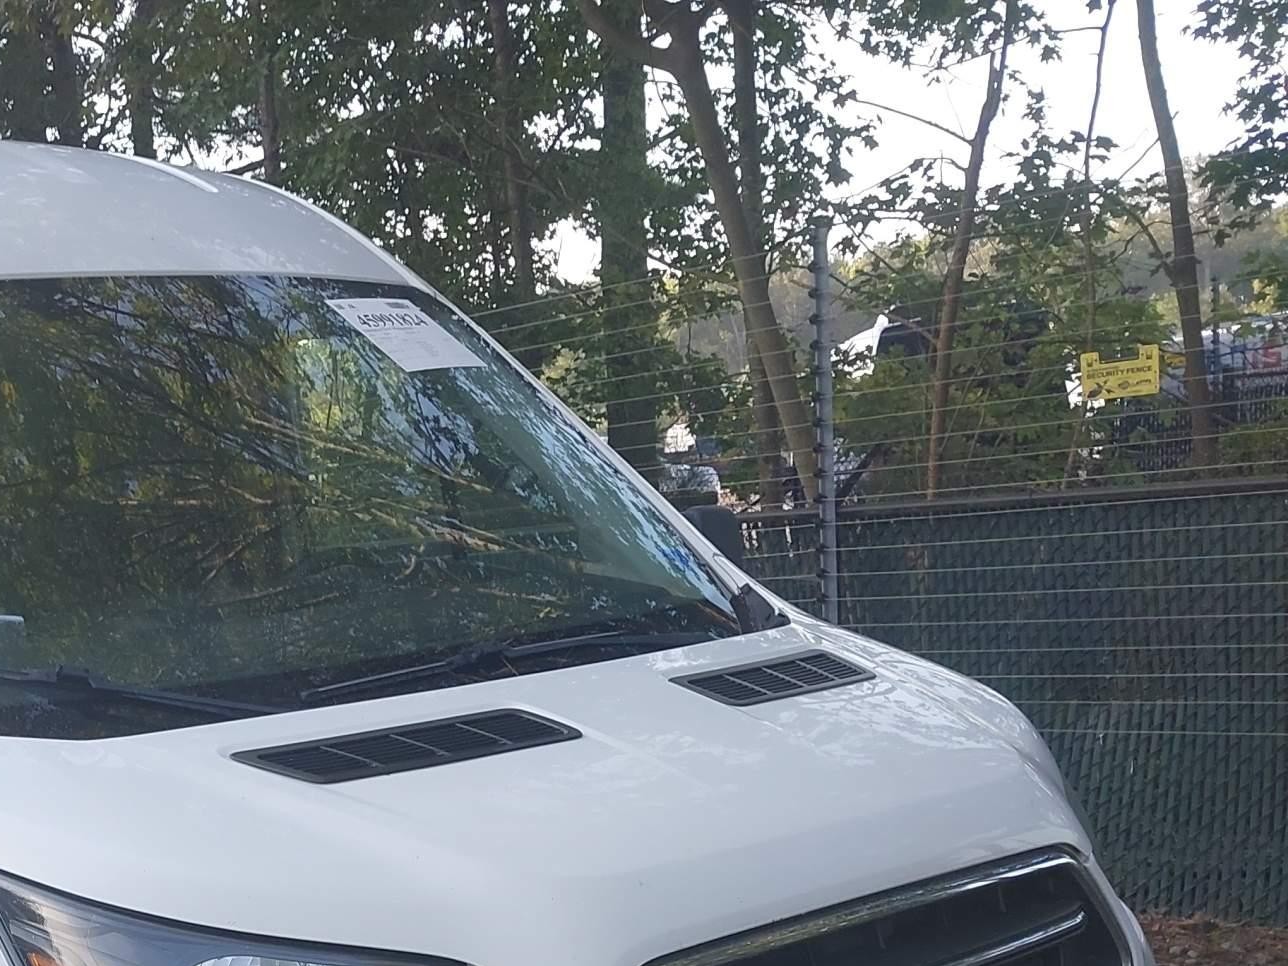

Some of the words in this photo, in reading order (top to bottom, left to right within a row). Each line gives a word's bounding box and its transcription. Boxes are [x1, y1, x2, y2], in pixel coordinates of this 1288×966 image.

[357, 312, 428, 328] 45991824
[1086, 368, 1125, 380] SECURITY
[1126, 365, 1153, 375] FENCE
